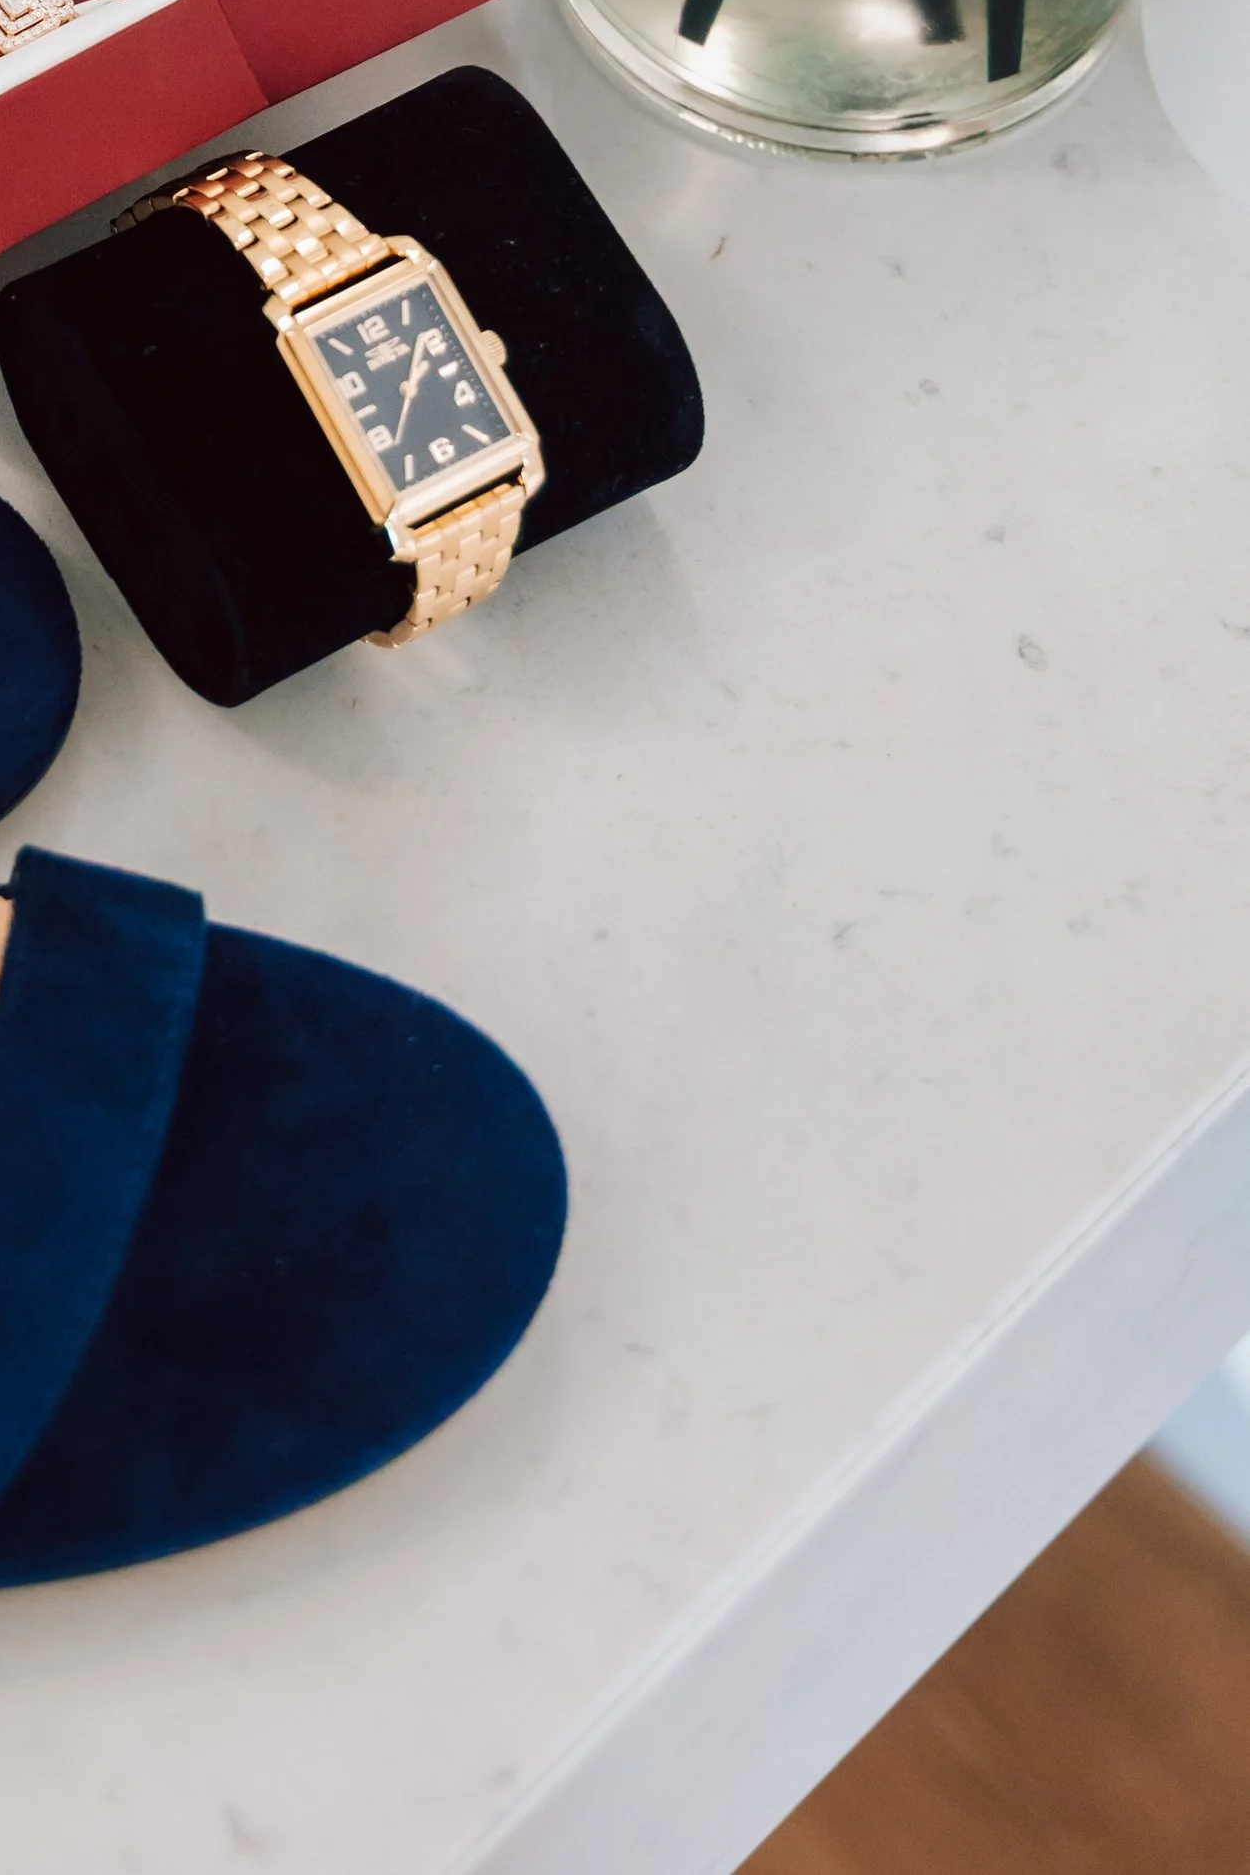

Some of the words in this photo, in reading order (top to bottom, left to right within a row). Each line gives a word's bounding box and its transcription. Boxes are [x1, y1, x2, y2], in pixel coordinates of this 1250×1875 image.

[356, 314, 391, 345] 12
[424, 328, 448, 357] 2
[335, 371, 367, 400] 10
[454, 379, 477, 408] 4
[366, 424, 393, 453] 8
[428, 437, 456, 465] 6
